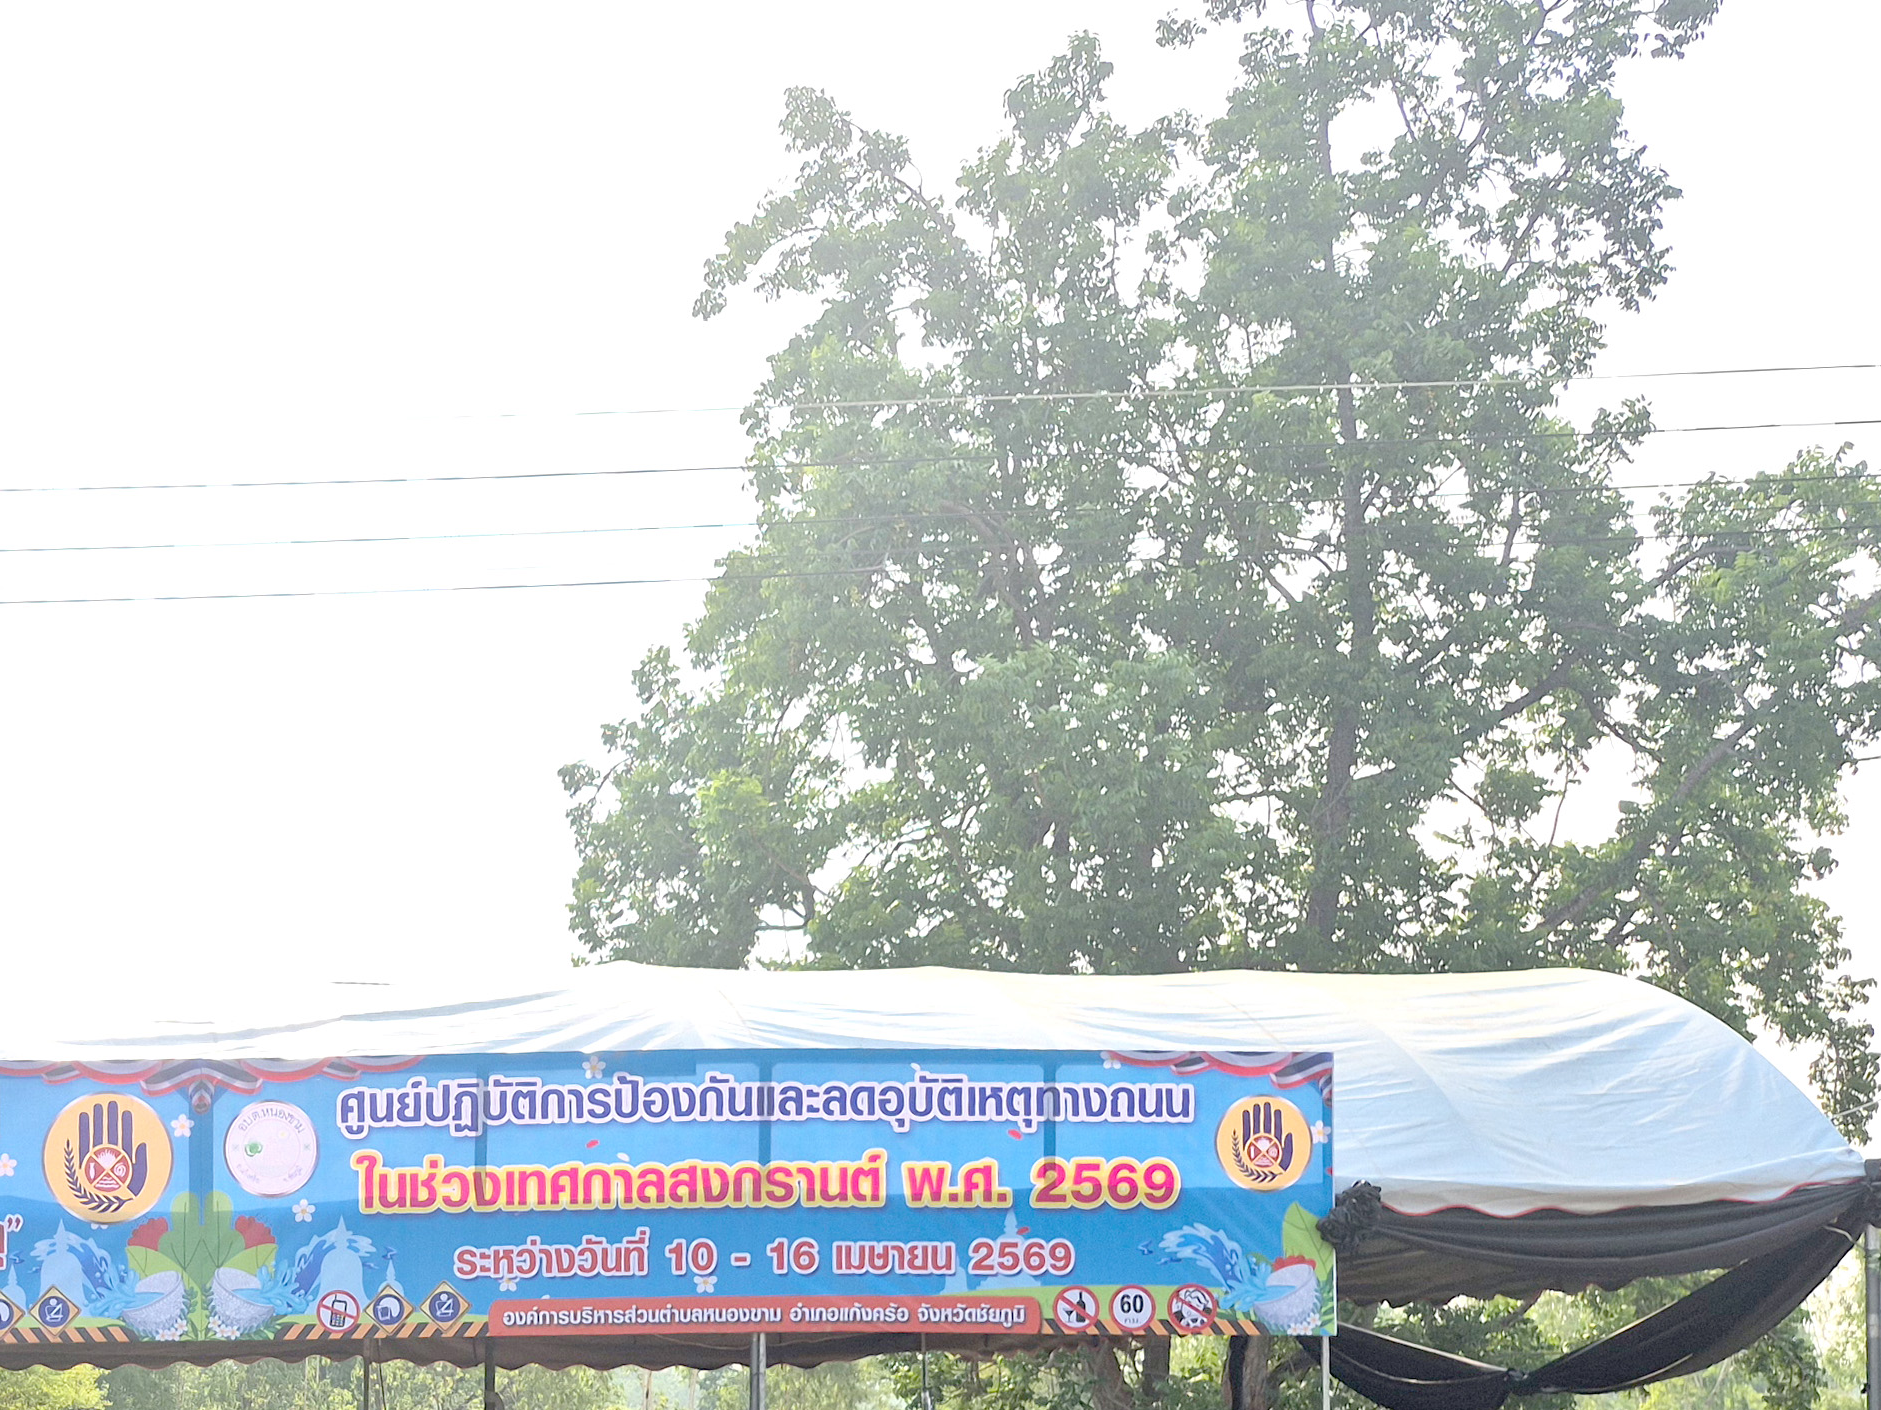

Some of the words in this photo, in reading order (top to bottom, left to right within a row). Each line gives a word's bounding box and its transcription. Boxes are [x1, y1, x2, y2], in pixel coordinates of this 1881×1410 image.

[340, 1074, 1191, 1132] ศูนย์ปฏิบัติการป้องกันและลดอุบัติเหตุทางถนน
[355, 1153, 882, 1209] ในช่วงเทศกาลสงกรานต์
[906, 1162, 1008, 1203] พ.ศ.
[1034, 1162, 1177, 1204] 2569
[456, 1230, 646, 1276] ระหว่างวันที่
[669, 1242, 715, 1273] 10
[769, 1241, 817, 1271] 16
[835, 1244, 952, 1271] เมษายน
[972, 1241, 1072, 1271] 2569
[503, 1303, 782, 1327] องค์การบริหารส่วนตำบลหนองขาม
[789, 1302, 909, 1323] อำเภอแก้งคร้อ
[917, 1304, 1025, 1328] จังหวัดชัยภูมิ
[1120, 1294, 1144, 1314] 60
